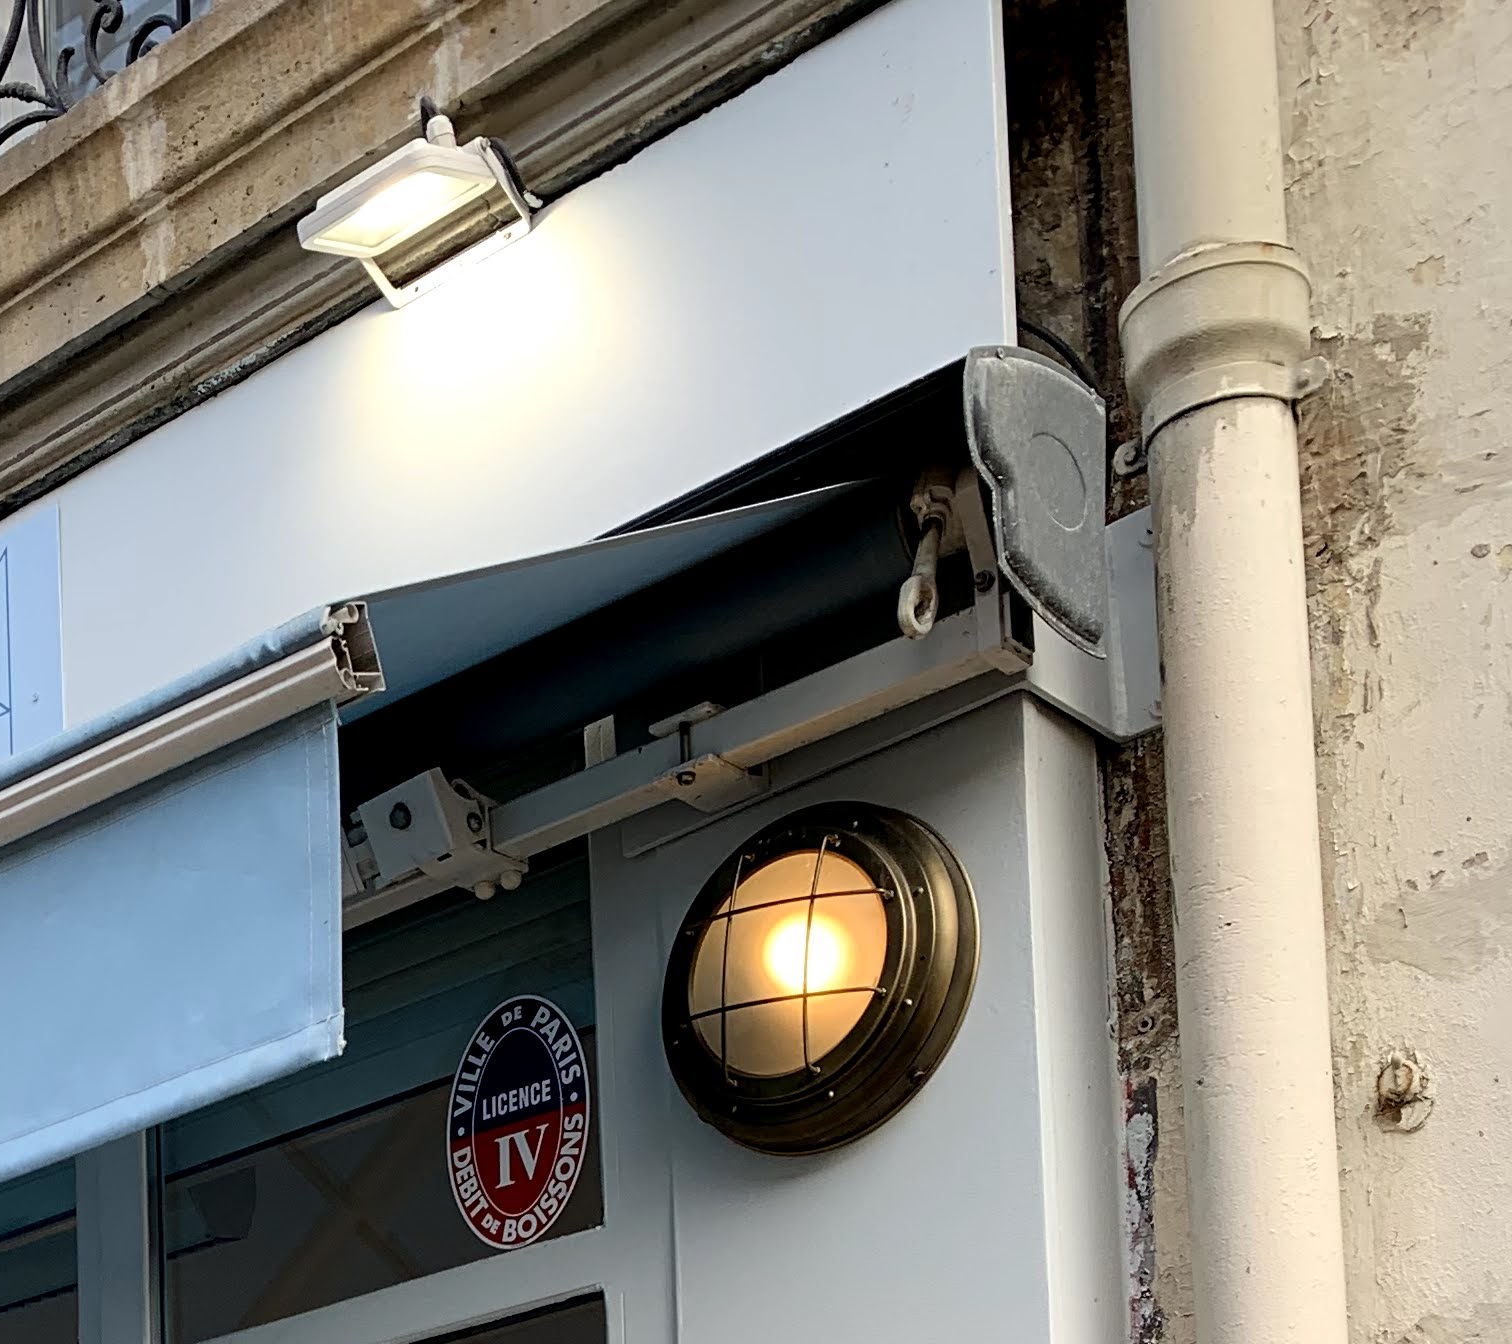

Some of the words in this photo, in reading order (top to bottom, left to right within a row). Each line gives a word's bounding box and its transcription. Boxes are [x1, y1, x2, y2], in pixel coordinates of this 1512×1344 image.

[453, 1031, 496, 1118] VILLE
[500, 1005, 524, 1028] DE
[530, 1005, 582, 1085] PARIS
[482, 1078, 552, 1121] LICENCE
[452, 1145, 489, 1218] DEBIT
[480, 1214, 502, 1236] DE
[501, 1112, 585, 1243] BOISSONS
[493, 1123, 550, 1190] IV
